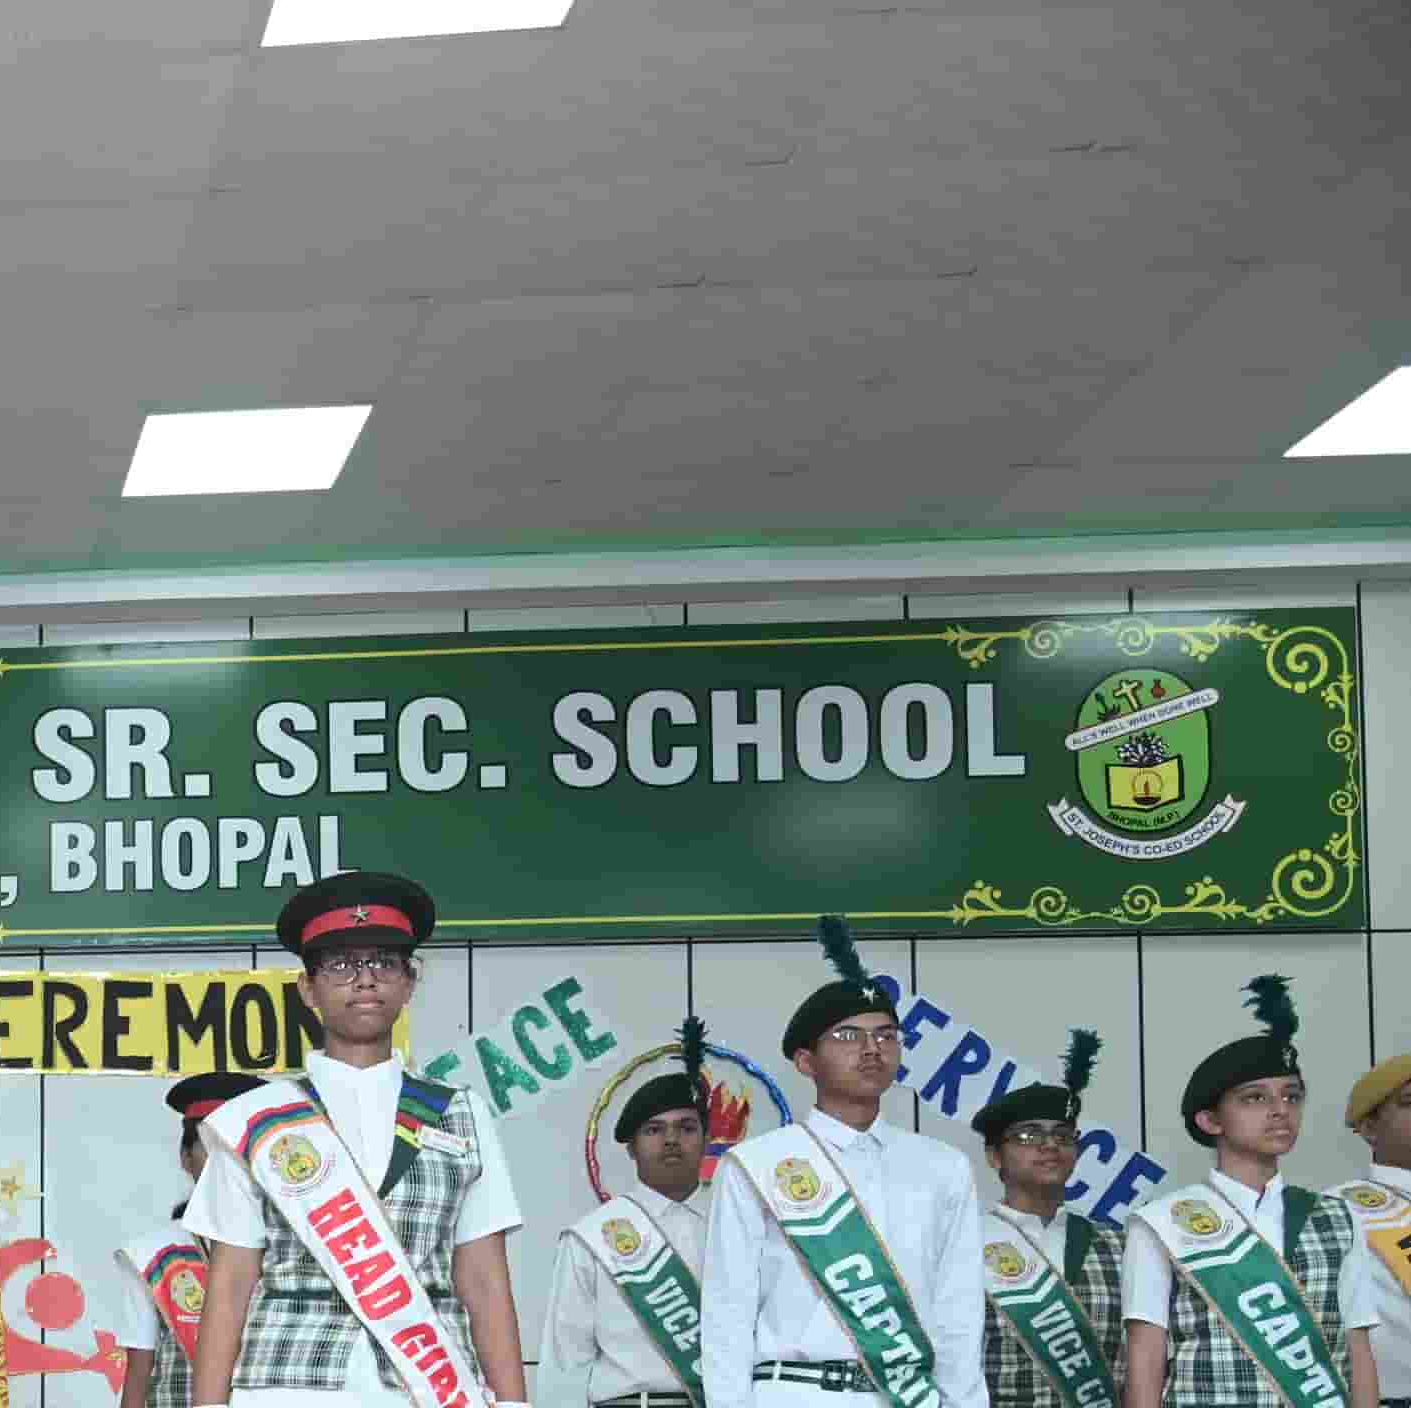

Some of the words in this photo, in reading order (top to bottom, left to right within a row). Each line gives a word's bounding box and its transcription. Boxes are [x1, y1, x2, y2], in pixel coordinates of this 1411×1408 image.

[32, 707, 211, 803] SR.
[254, 696, 507, 797] SEC.
[551, 683, 1026, 788] SCHOOL
[50, 814, 357, 893] BHOPAL
[306, 1187, 414, 1322] HEAD
[1029, 1299, 1092, 1379] VICE
